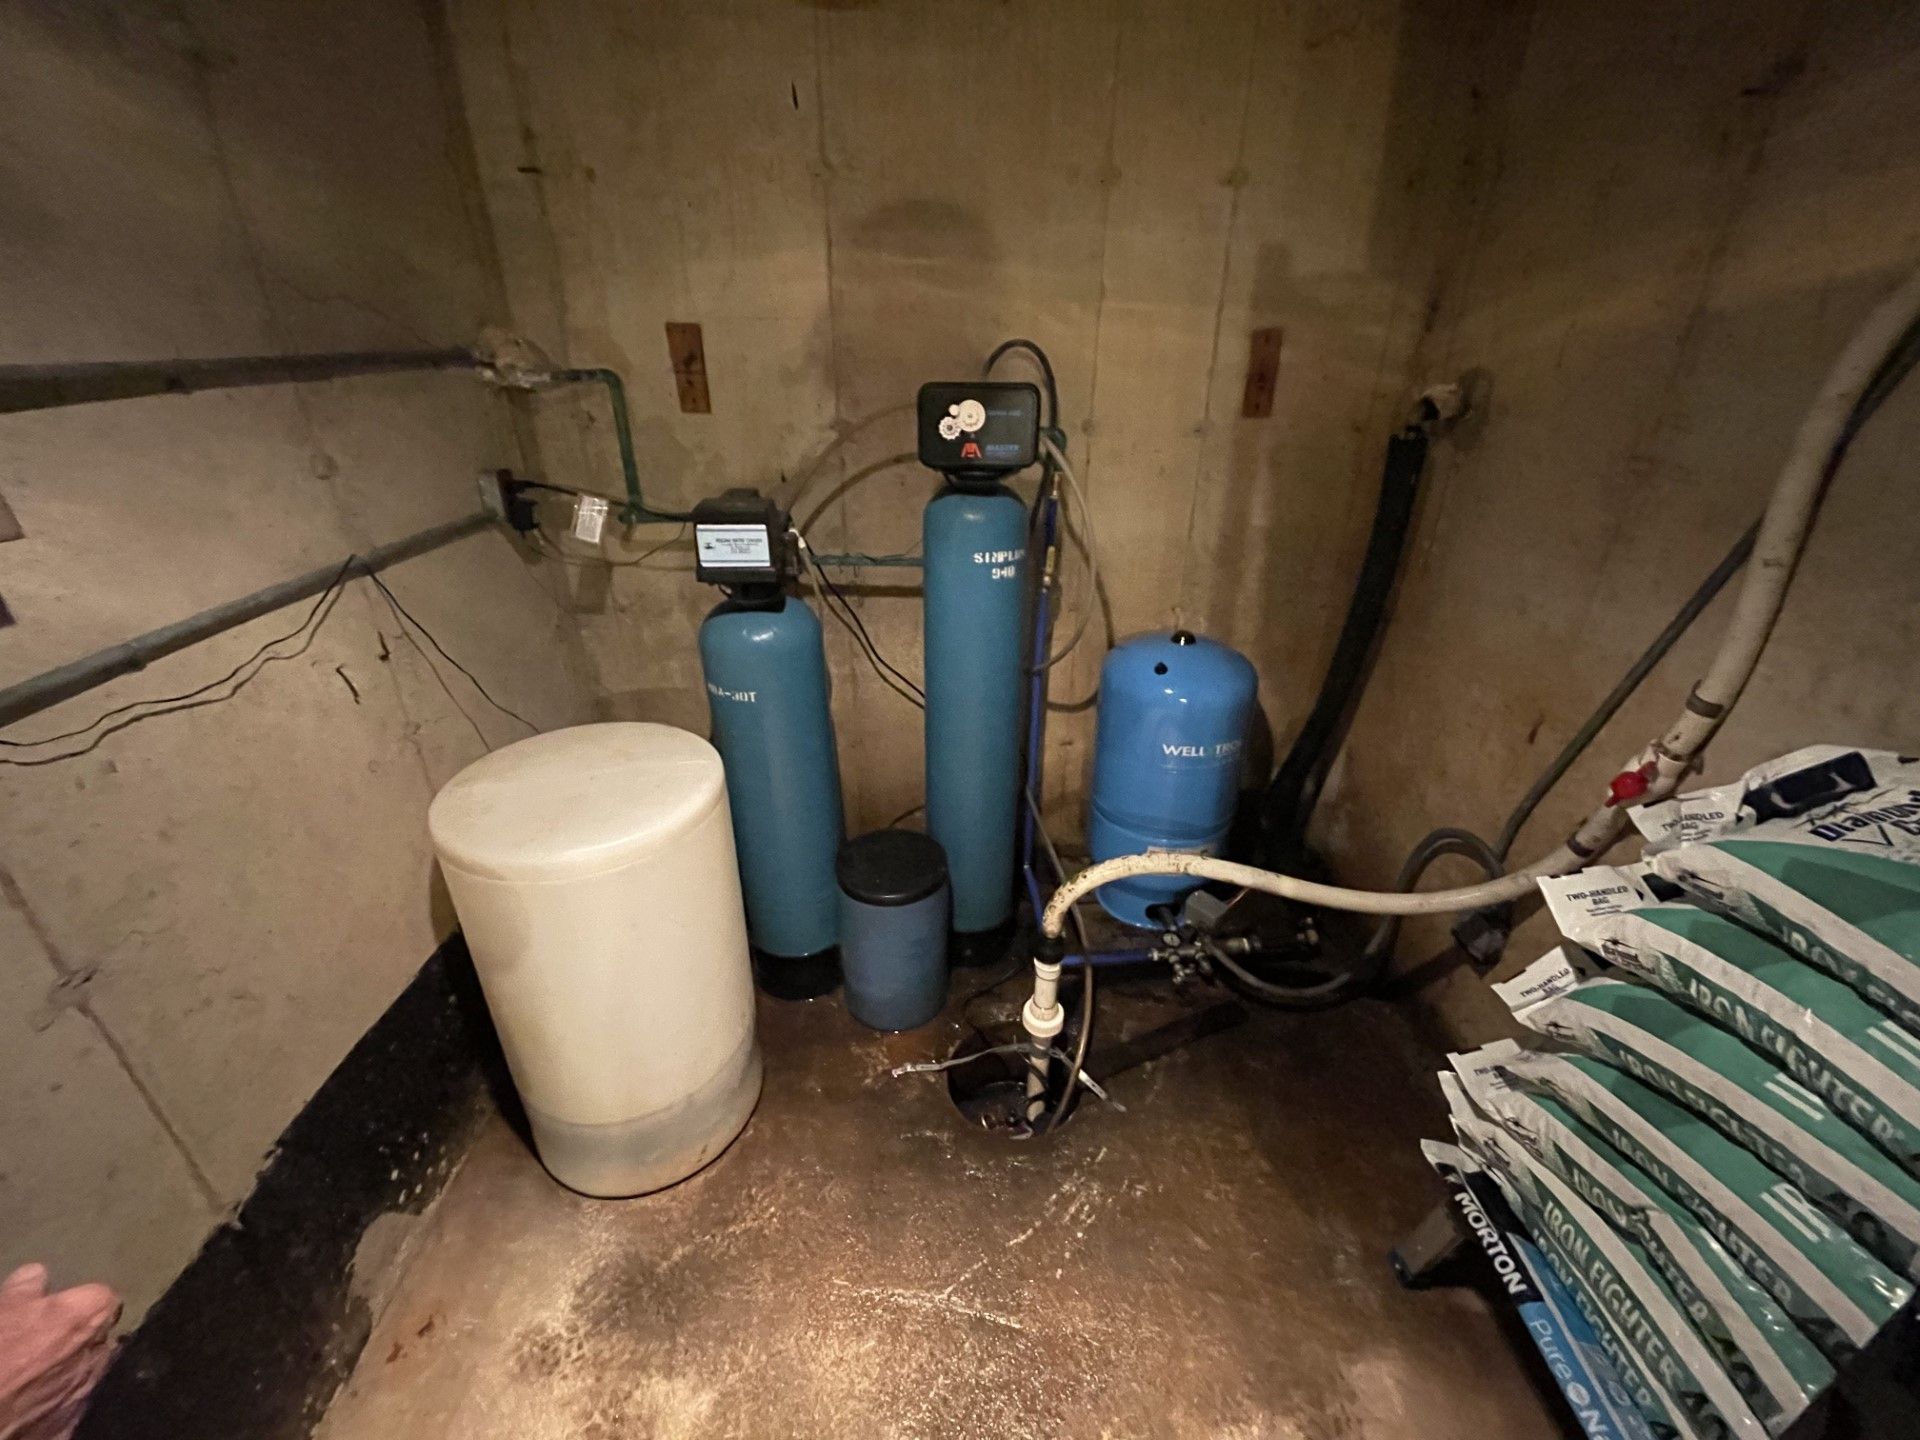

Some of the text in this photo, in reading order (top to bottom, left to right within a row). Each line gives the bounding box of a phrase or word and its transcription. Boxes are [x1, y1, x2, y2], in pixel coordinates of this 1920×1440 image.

[992, 565, 1016, 579] 940
[1162, 743, 1205, 757] WELL
[1689, 978, 1755, 1042] IRON
[1454, 1192, 1528, 1295] MORTON
[1543, 1201, 1590, 1268] IRON
[1588, 1259, 1684, 1391] FIGHTER
[1530, 1319, 1573, 1380] Pure
